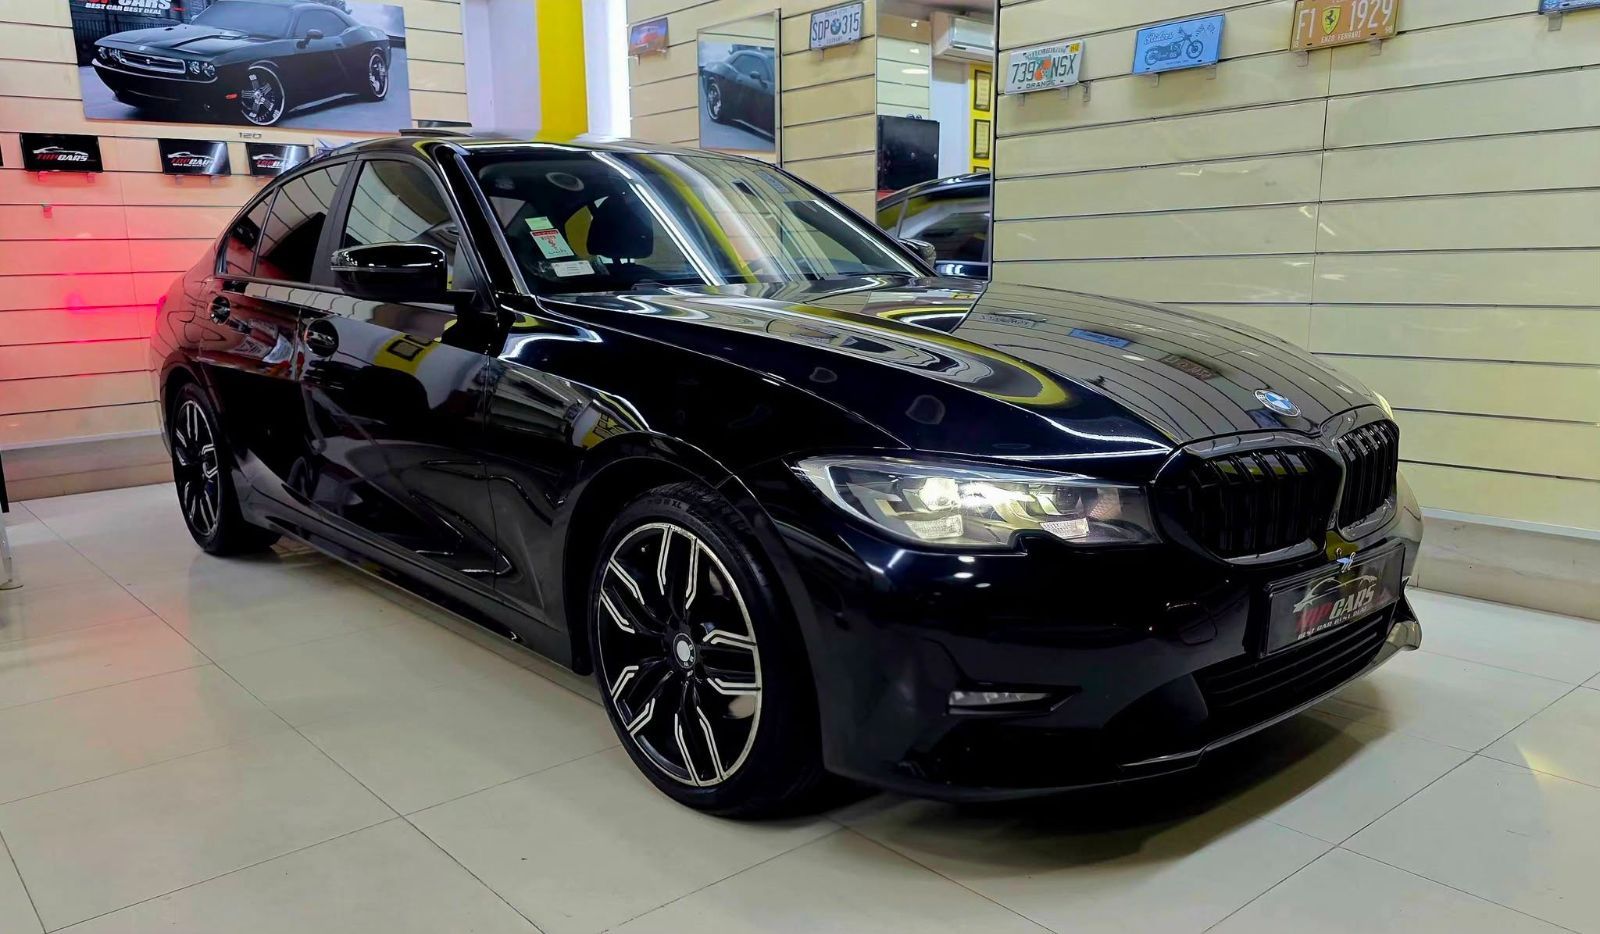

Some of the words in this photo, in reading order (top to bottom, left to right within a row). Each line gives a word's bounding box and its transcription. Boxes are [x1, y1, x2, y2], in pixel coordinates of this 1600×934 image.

[812, 19, 830, 41] SDP
[841, 12, 860, 35] 315
[1297, 8, 1316, 40] F1
[1349, 0, 1393, 31] 1929
[1338, 31, 1361, 41] FERRARI
[1012, 61, 1036, 84] 739
[1051, 54, 1077, 78] NSX
[1026, 80, 1056, 89] ORANGE
